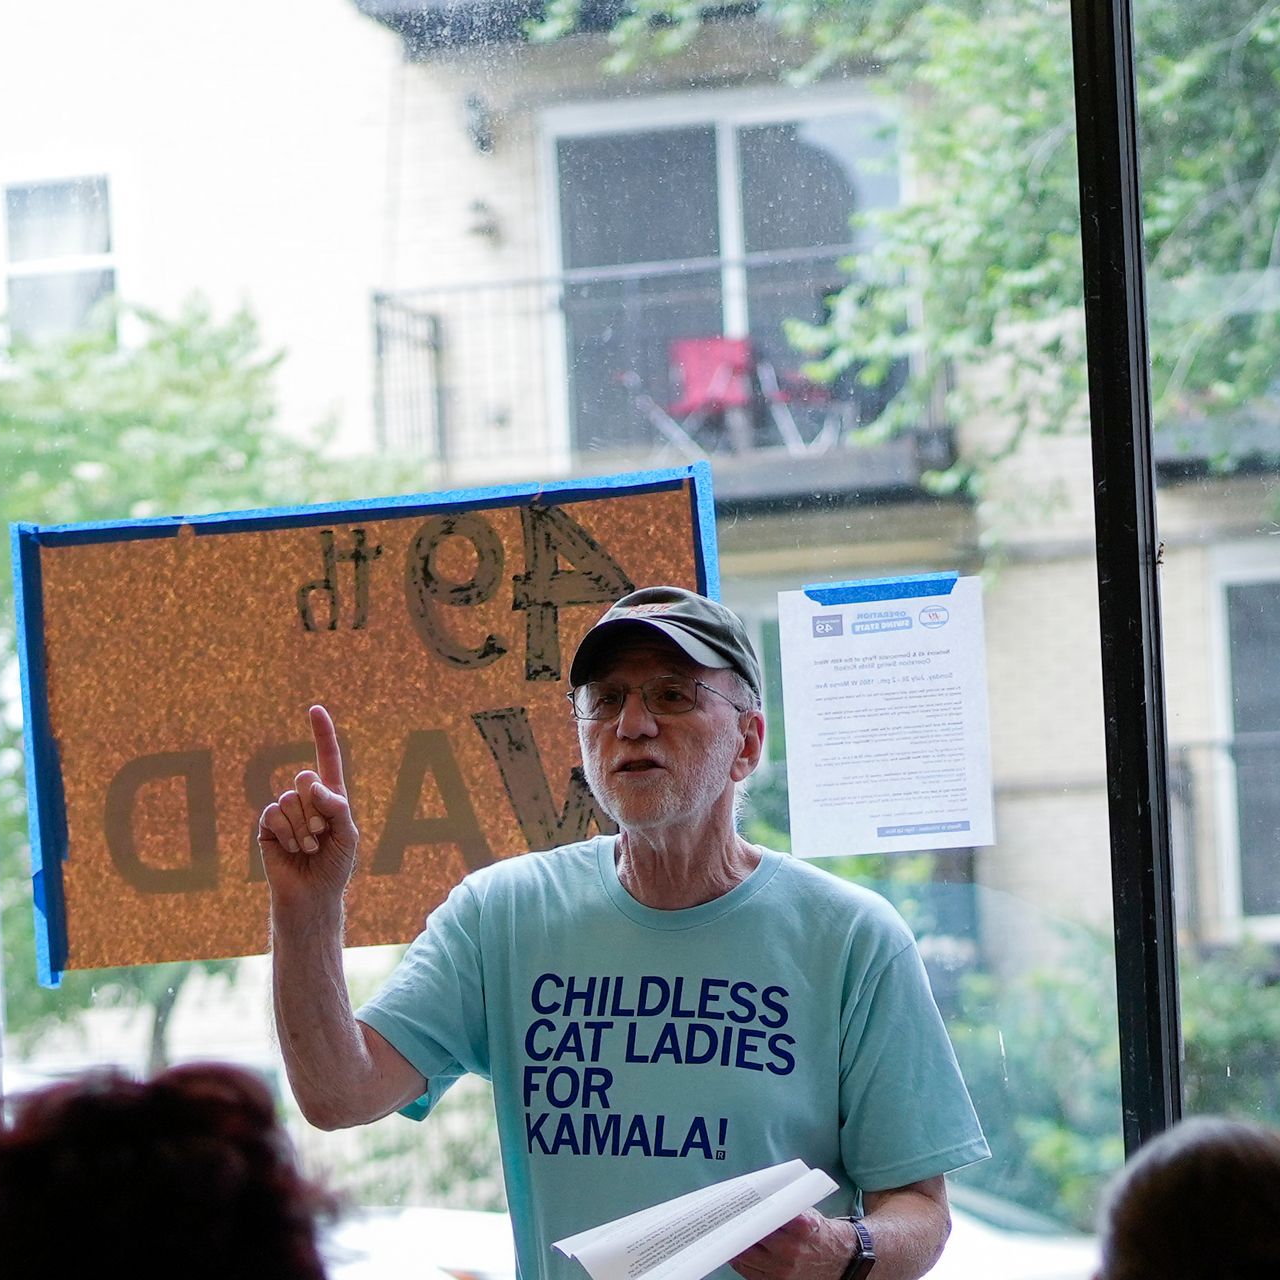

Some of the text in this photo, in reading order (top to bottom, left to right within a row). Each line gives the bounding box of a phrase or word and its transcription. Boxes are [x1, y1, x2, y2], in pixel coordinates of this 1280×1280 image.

[531, 973, 790, 1029] CHILDLESS
[524, 1018, 797, 1076] CAT LADIES
[523, 1065, 614, 1109] FOR
[525, 1112, 729, 1160] KAMALA!
